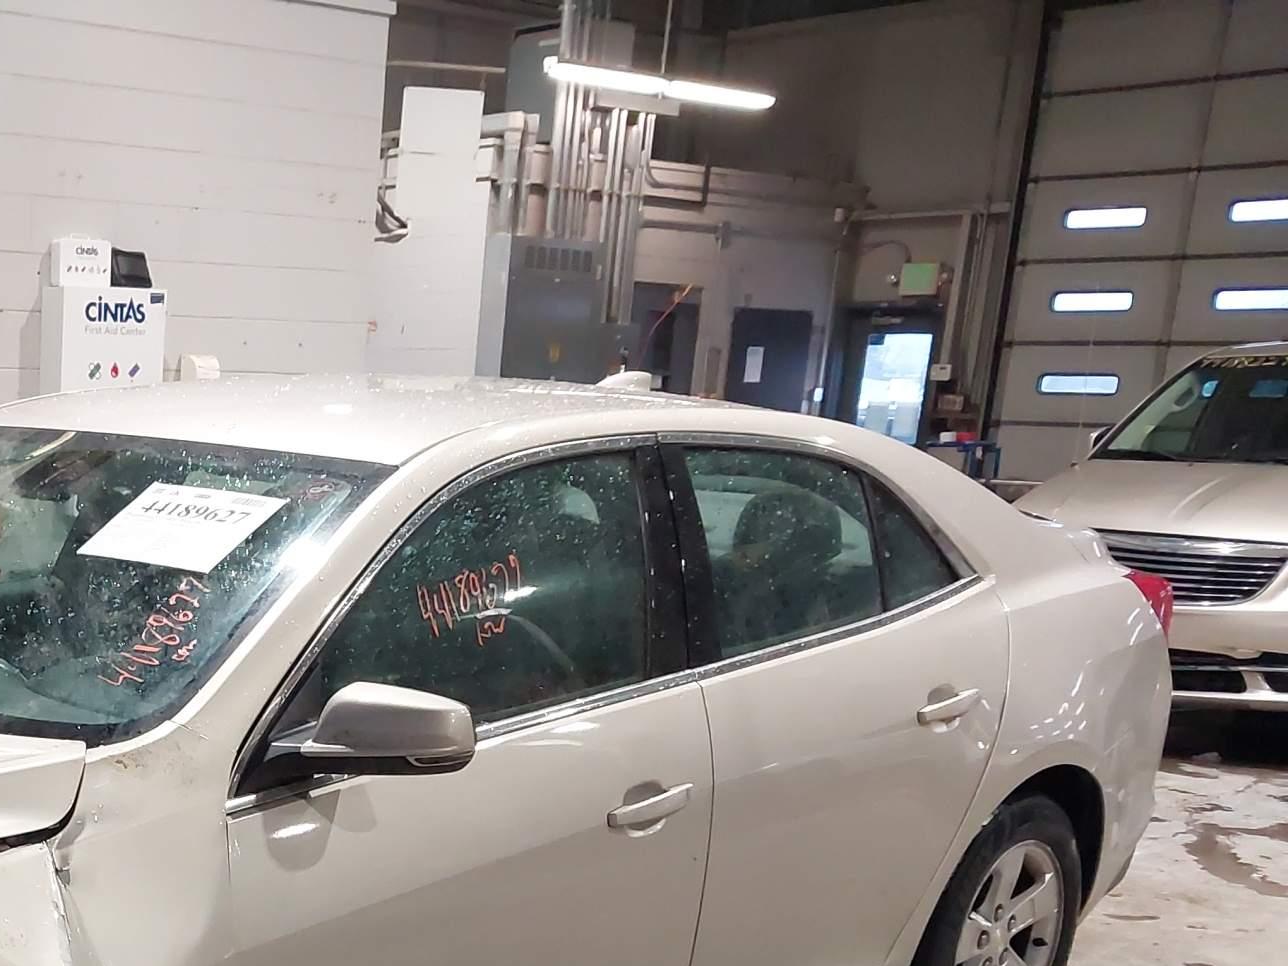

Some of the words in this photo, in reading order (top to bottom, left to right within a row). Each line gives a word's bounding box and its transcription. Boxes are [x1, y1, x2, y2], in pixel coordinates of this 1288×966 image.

[84, 325, 103, 335] First
[104, 325, 118, 335] Aid
[120, 326, 146, 336] Center
[141, 500, 251, 525] 44189627
